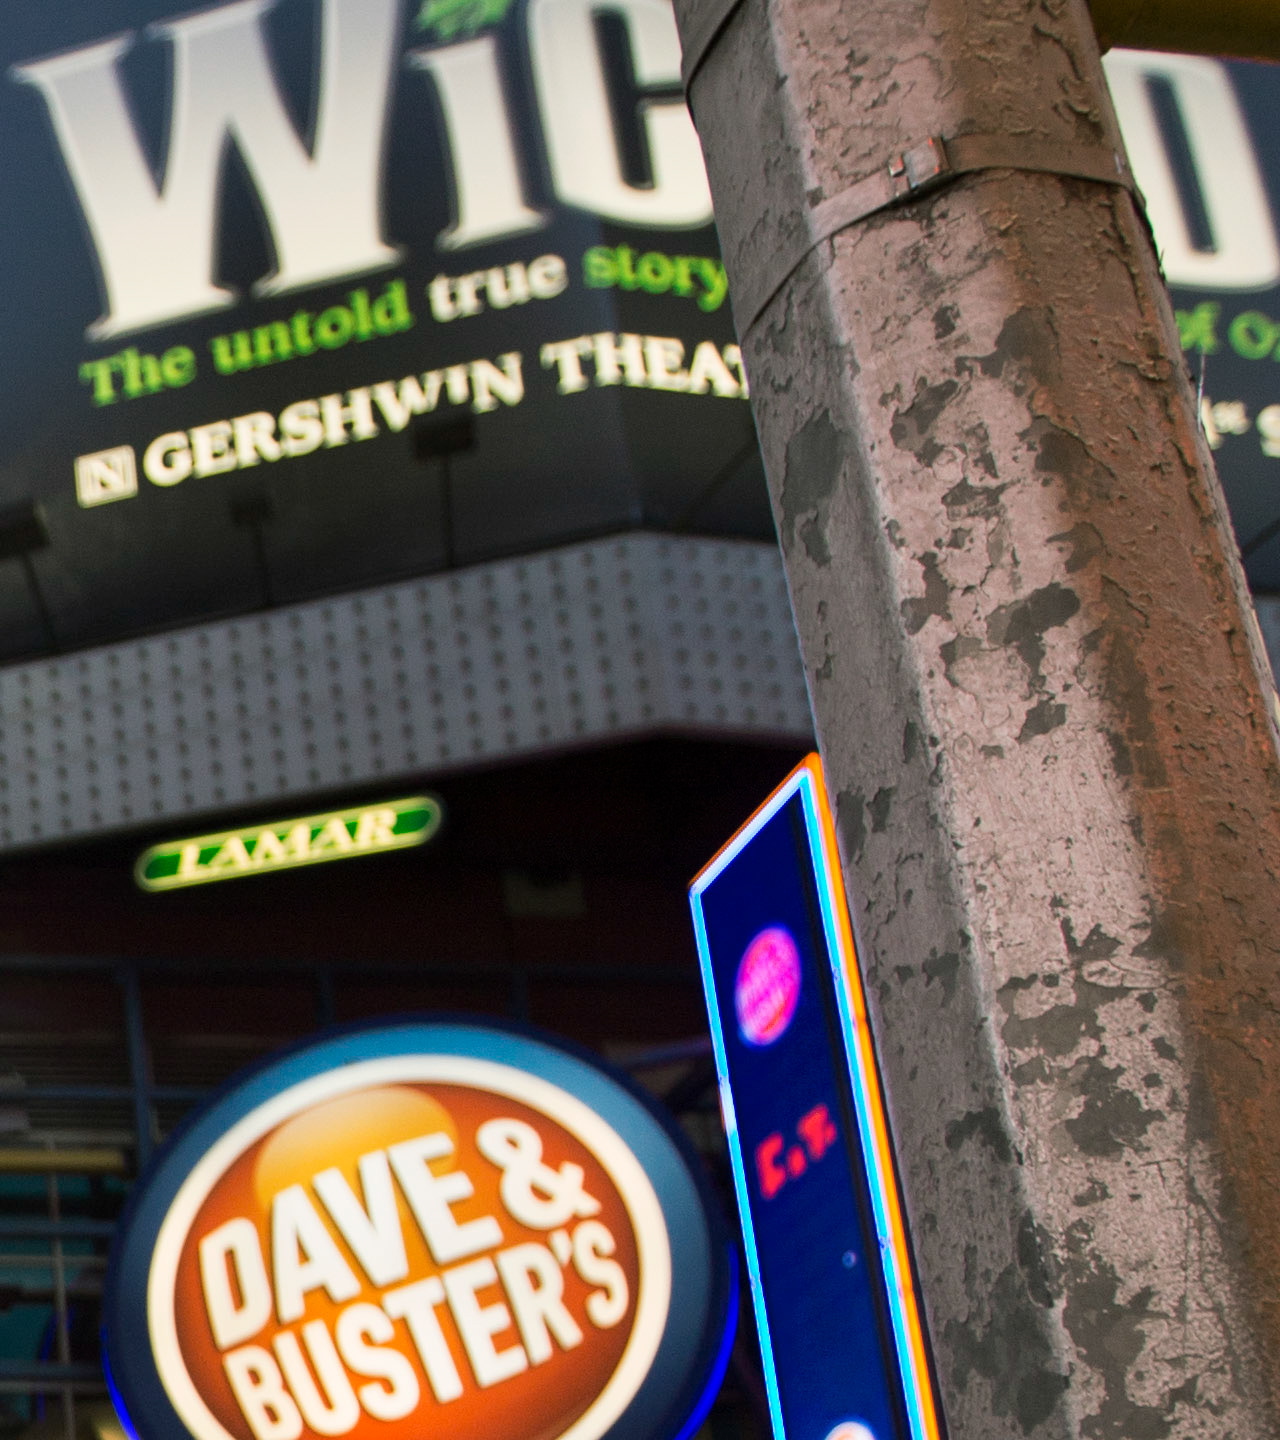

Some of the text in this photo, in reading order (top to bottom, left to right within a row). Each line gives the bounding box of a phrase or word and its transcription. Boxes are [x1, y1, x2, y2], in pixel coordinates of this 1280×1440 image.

[78, 347, 196, 407] The
[212, 279, 411, 377] untold
[427, 251, 567, 323] true
[582, 243, 730, 312] story
[142, 352, 526, 488] GERSHWIN
[177, 809, 398, 881] LAMAR
[198, 1132, 503, 1351] DAVE
[474, 1117, 603, 1230] &
